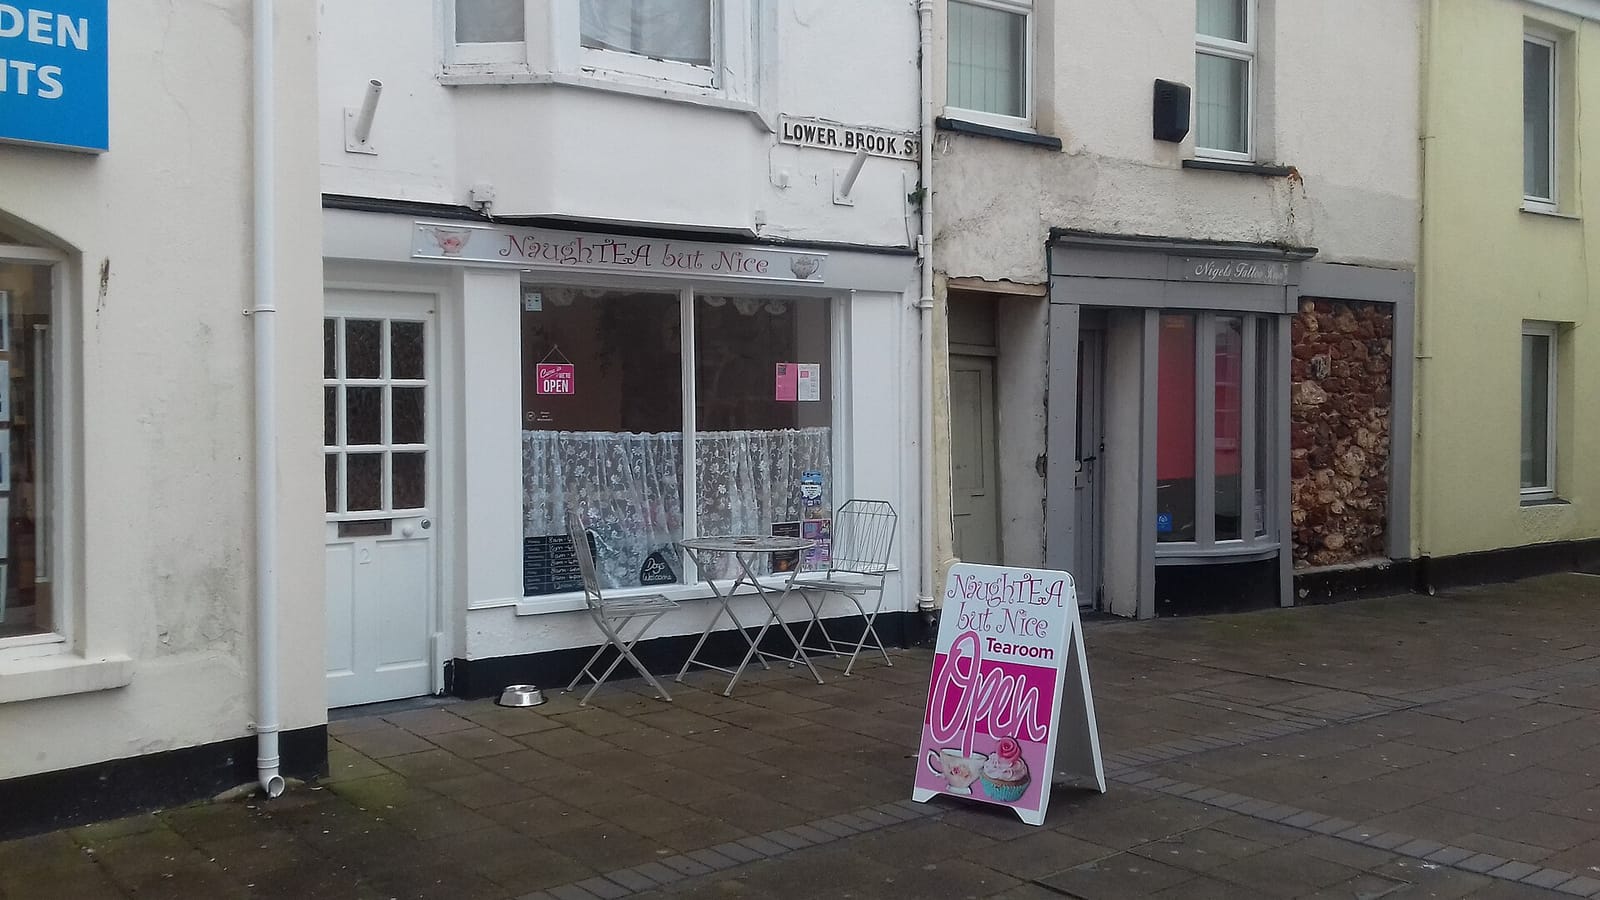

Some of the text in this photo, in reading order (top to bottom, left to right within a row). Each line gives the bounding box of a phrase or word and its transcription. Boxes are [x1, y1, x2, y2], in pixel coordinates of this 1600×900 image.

[498, 234, 769, 274] NaughTEA but Nice
[543, 379, 569, 393] OPEN
[359, 548, 372, 565] 2
[644, 557, 665, 575] Dogs
[947, 572, 1064, 607] NaughTEA
[956, 602, 1049, 638] but Nice
[986, 637, 1054, 660] Tearoom
[929, 631, 1047, 758] Open
